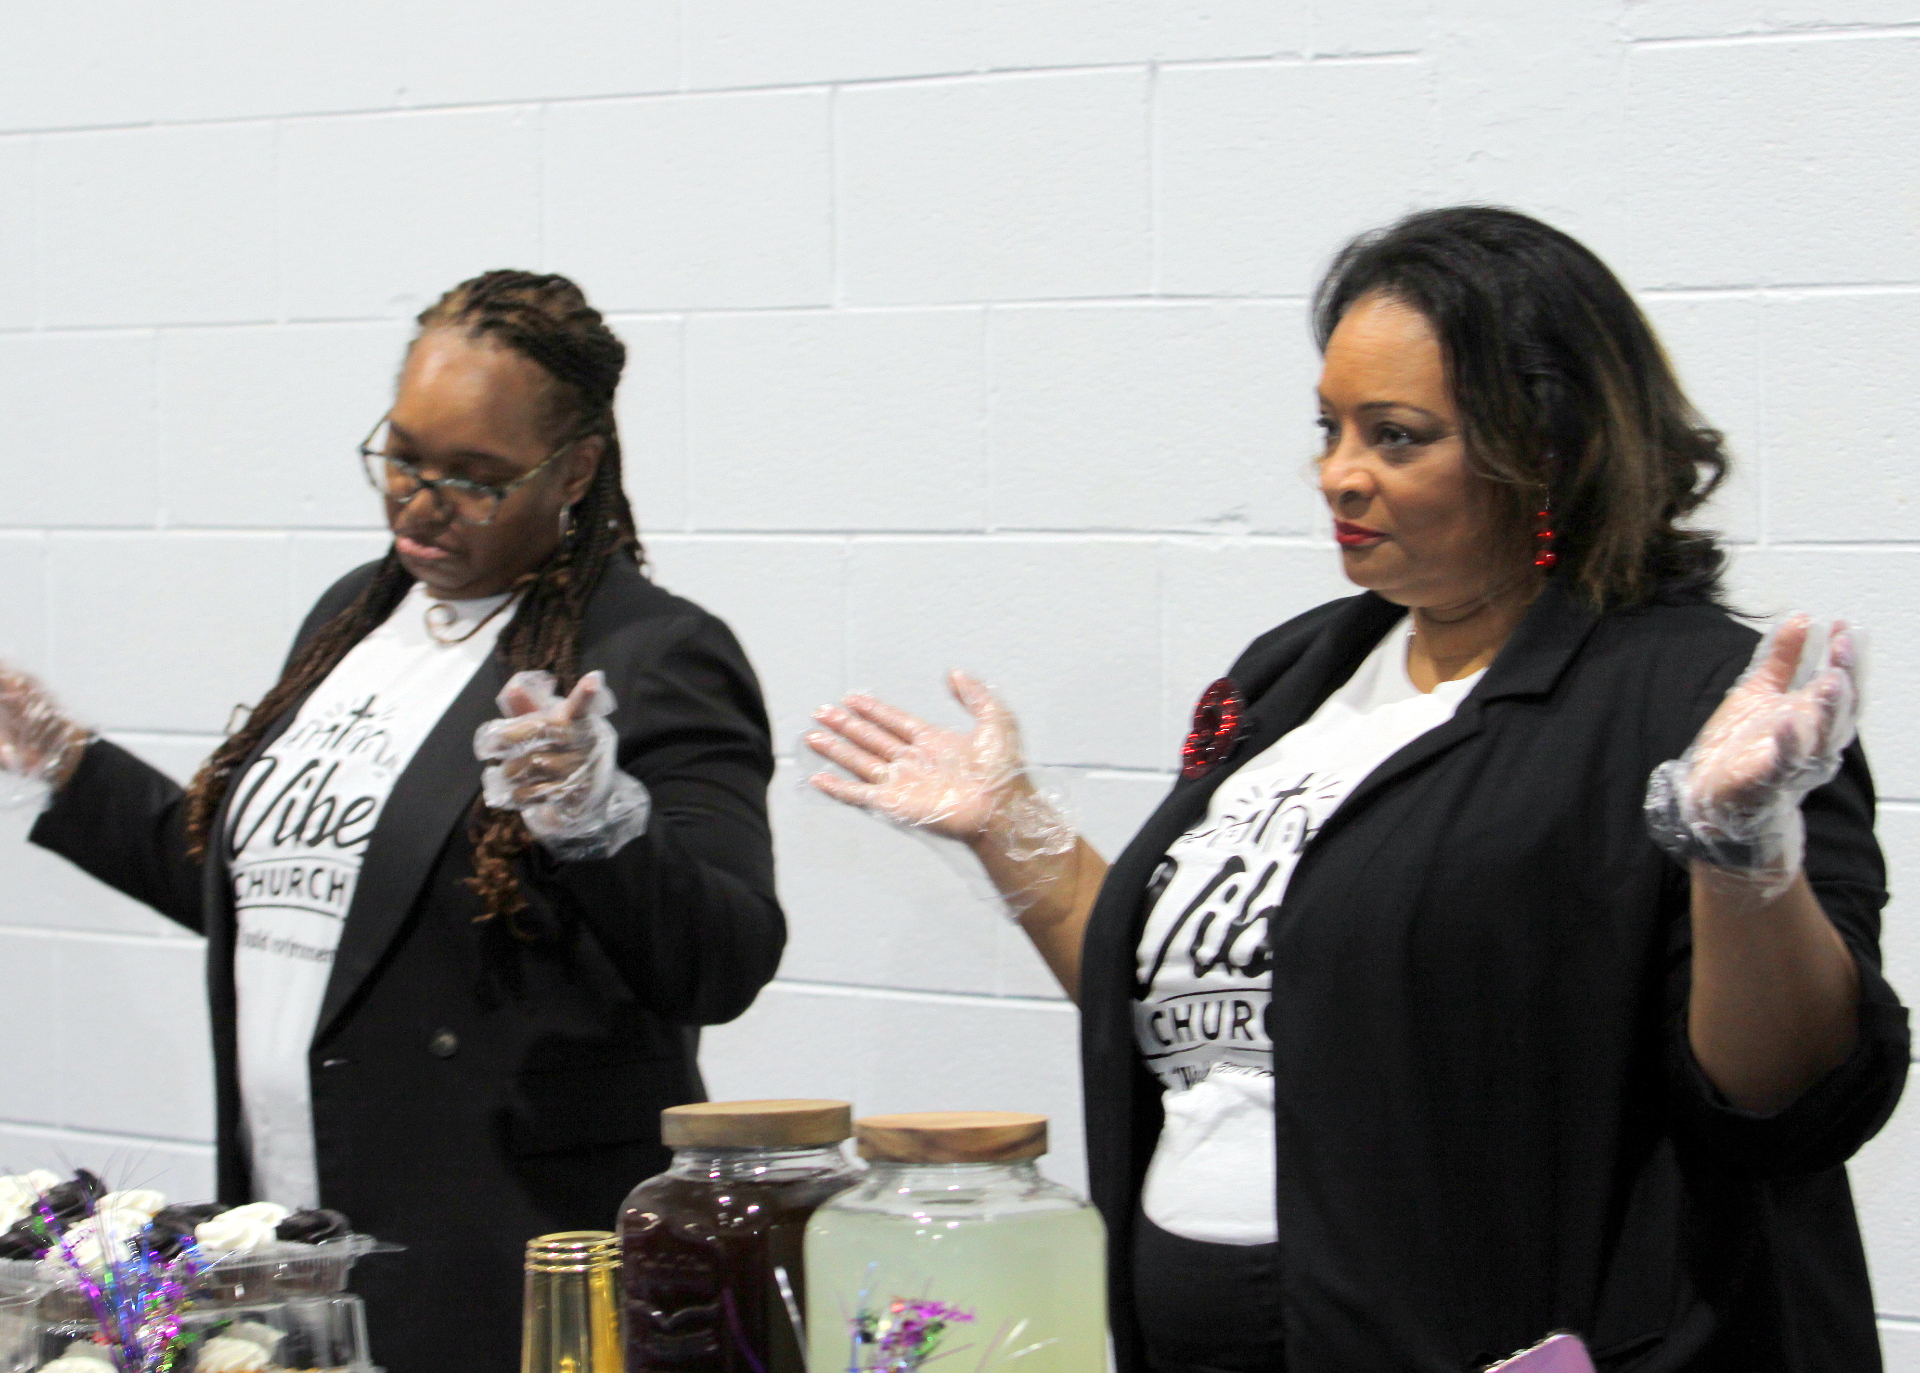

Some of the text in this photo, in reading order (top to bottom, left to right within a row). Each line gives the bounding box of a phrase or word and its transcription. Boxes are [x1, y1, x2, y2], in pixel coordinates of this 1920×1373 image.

[225, 756, 377, 860] Vibe
[234, 866, 349, 907] CHURCH
[1136, 854, 1281, 1001] Vib
